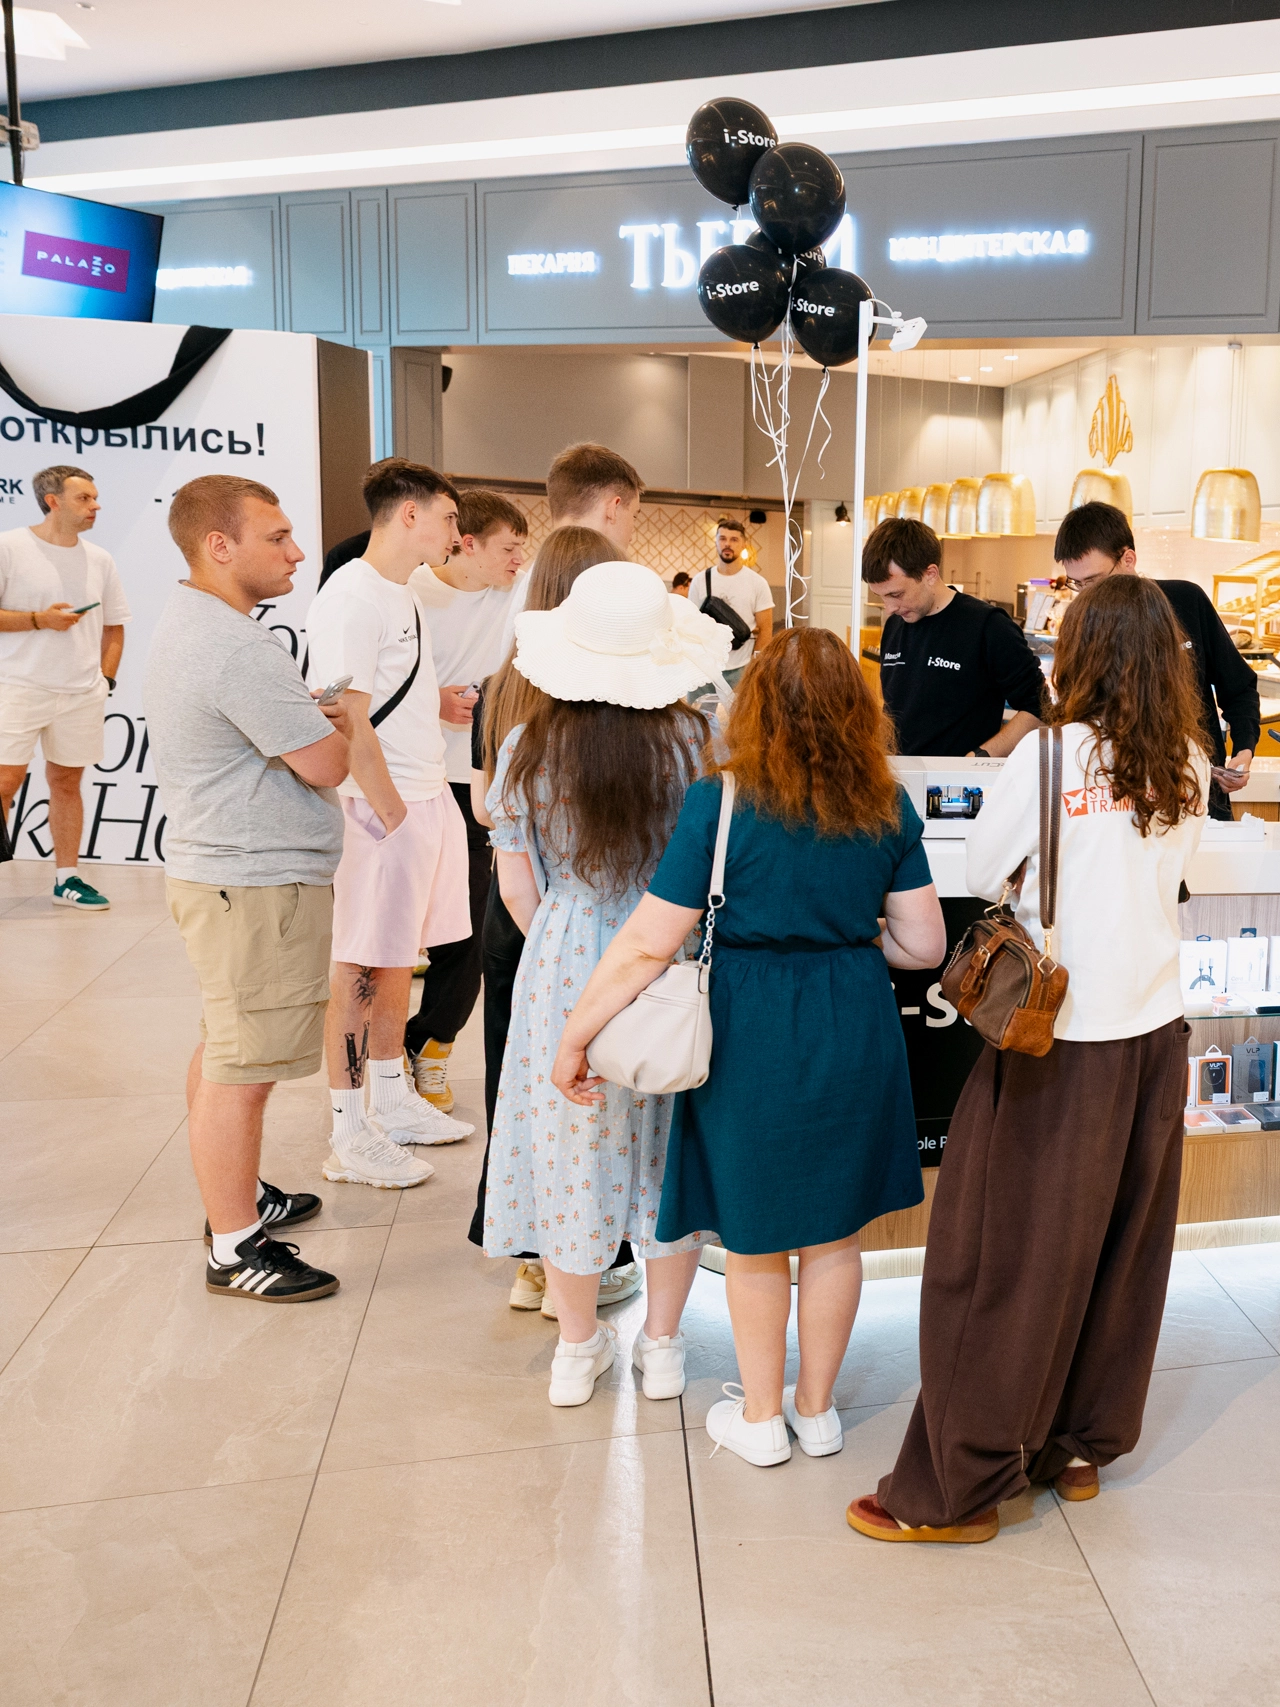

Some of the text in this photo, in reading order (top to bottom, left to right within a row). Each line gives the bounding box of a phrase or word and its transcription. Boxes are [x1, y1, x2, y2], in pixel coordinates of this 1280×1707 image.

[723, 128, 776, 148] i-Store
[508, 251, 597, 276] ПЕКАРНЯ
[706, 279, 760, 300] i-Store
[790, 298, 836, 316] i-Store
[927, 656, 961, 671] i-Store
